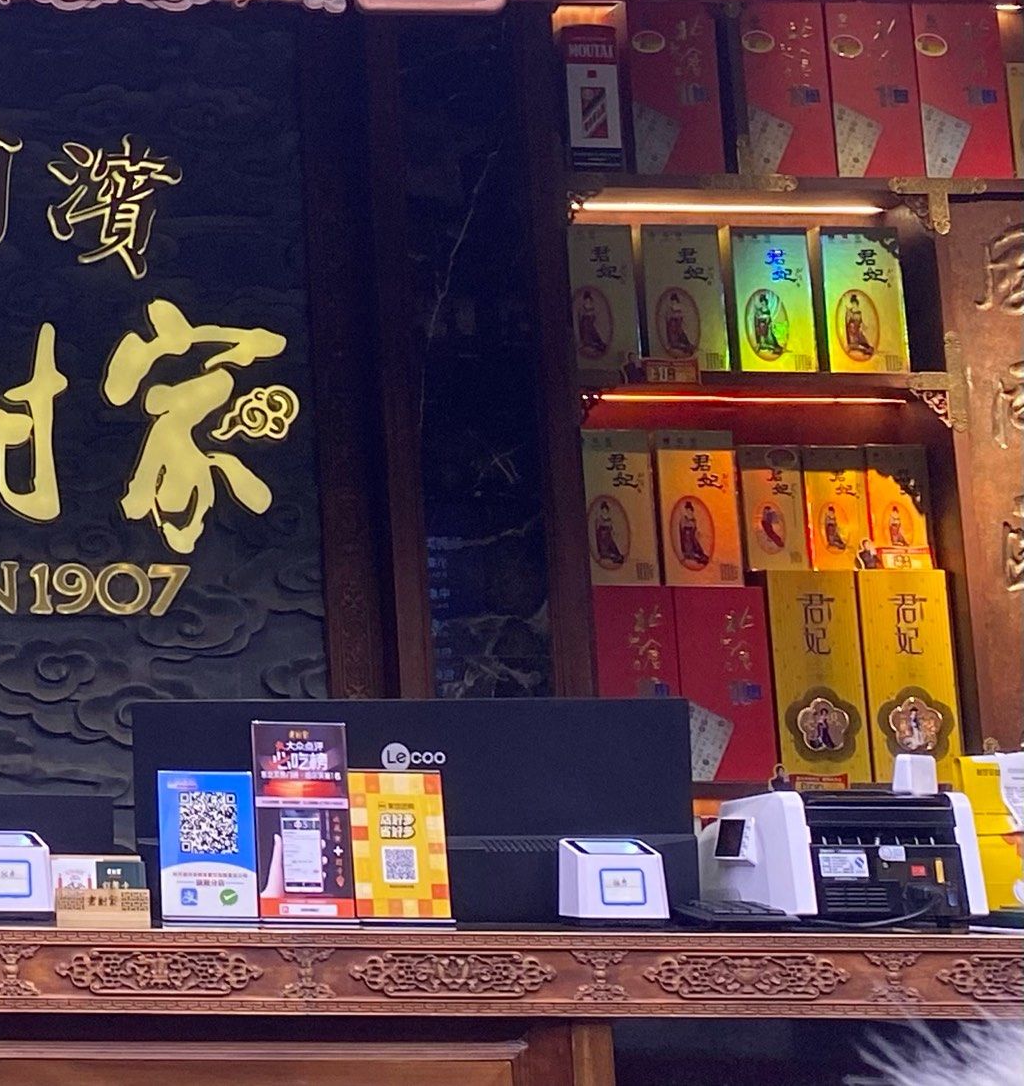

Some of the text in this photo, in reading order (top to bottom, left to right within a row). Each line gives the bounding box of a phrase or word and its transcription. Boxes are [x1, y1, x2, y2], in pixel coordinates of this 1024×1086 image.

[690, 454, 725, 490] 君妃
[31, 561, 191, 617] 1907
[796, 593, 836, 655] 君妃
[887, 593, 928, 656] 君妃
[385, 748, 447, 765] Lecoo
